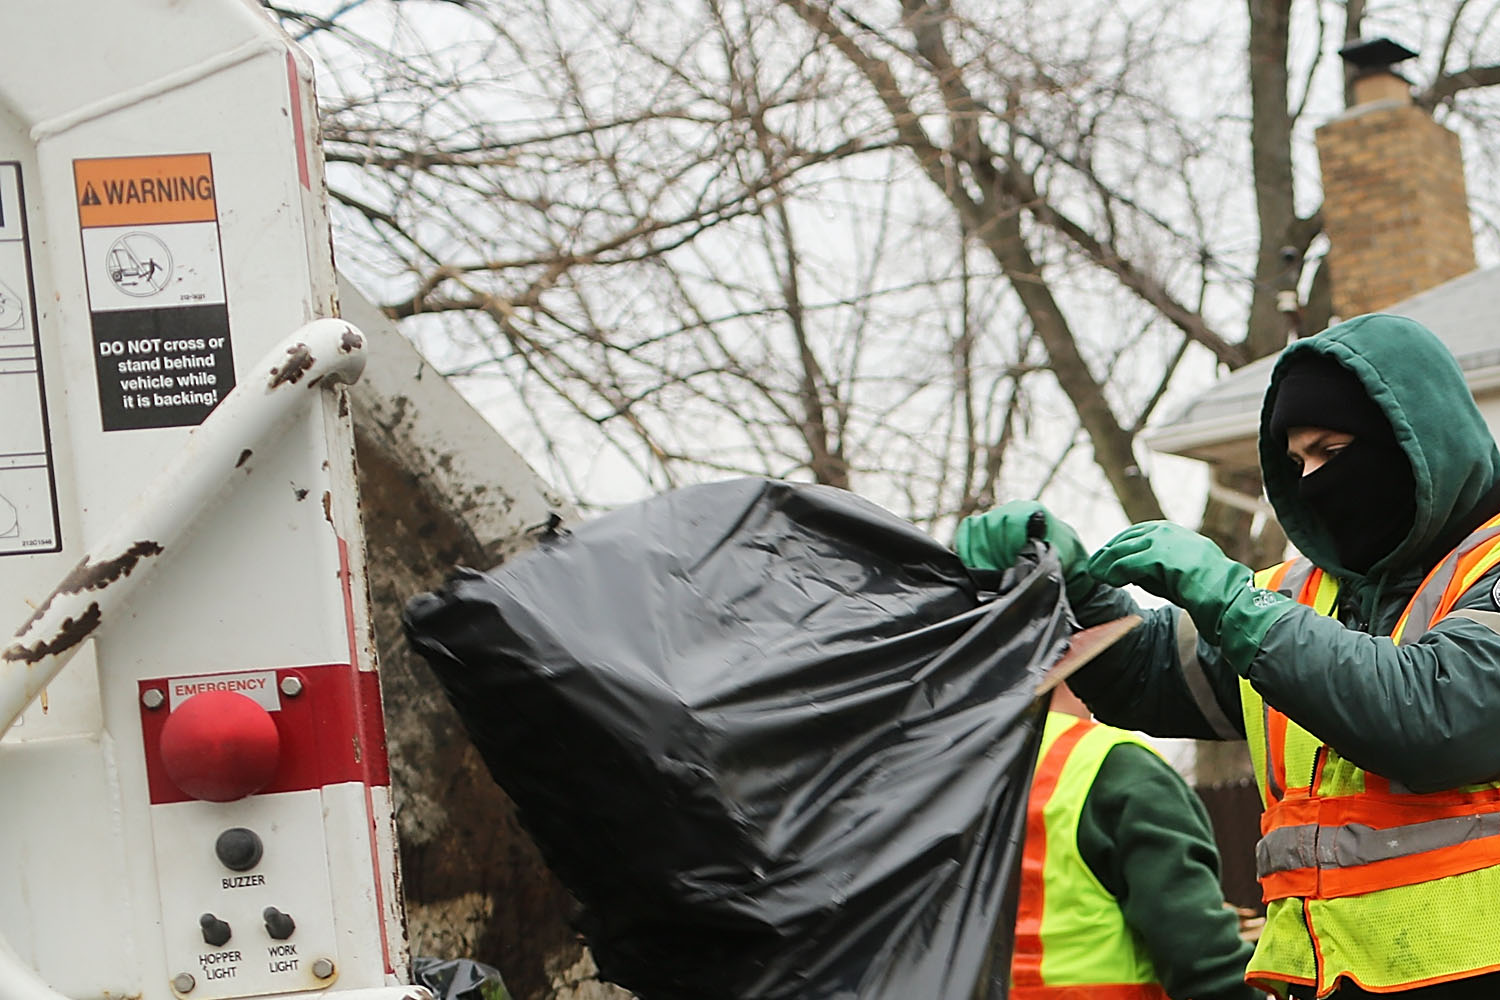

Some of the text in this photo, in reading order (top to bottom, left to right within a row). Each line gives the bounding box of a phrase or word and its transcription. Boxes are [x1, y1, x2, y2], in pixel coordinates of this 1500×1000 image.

[103, 175, 212, 205] WARNING
[100, 337, 225, 356] DO NOT cross or
[118, 353, 215, 373] stand behind
[120, 371, 217, 391] vehicle while
[122, 389, 218, 408] it is backing!
[175, 678, 267, 696] EMERGENCY
[222, 874, 266, 889] BUZZER
[199, 951, 242, 965] HOPPER
[268, 944, 298, 957] WORK
[206, 966, 237, 980] LIGHT
[268, 959, 299, 973] LIGHT
